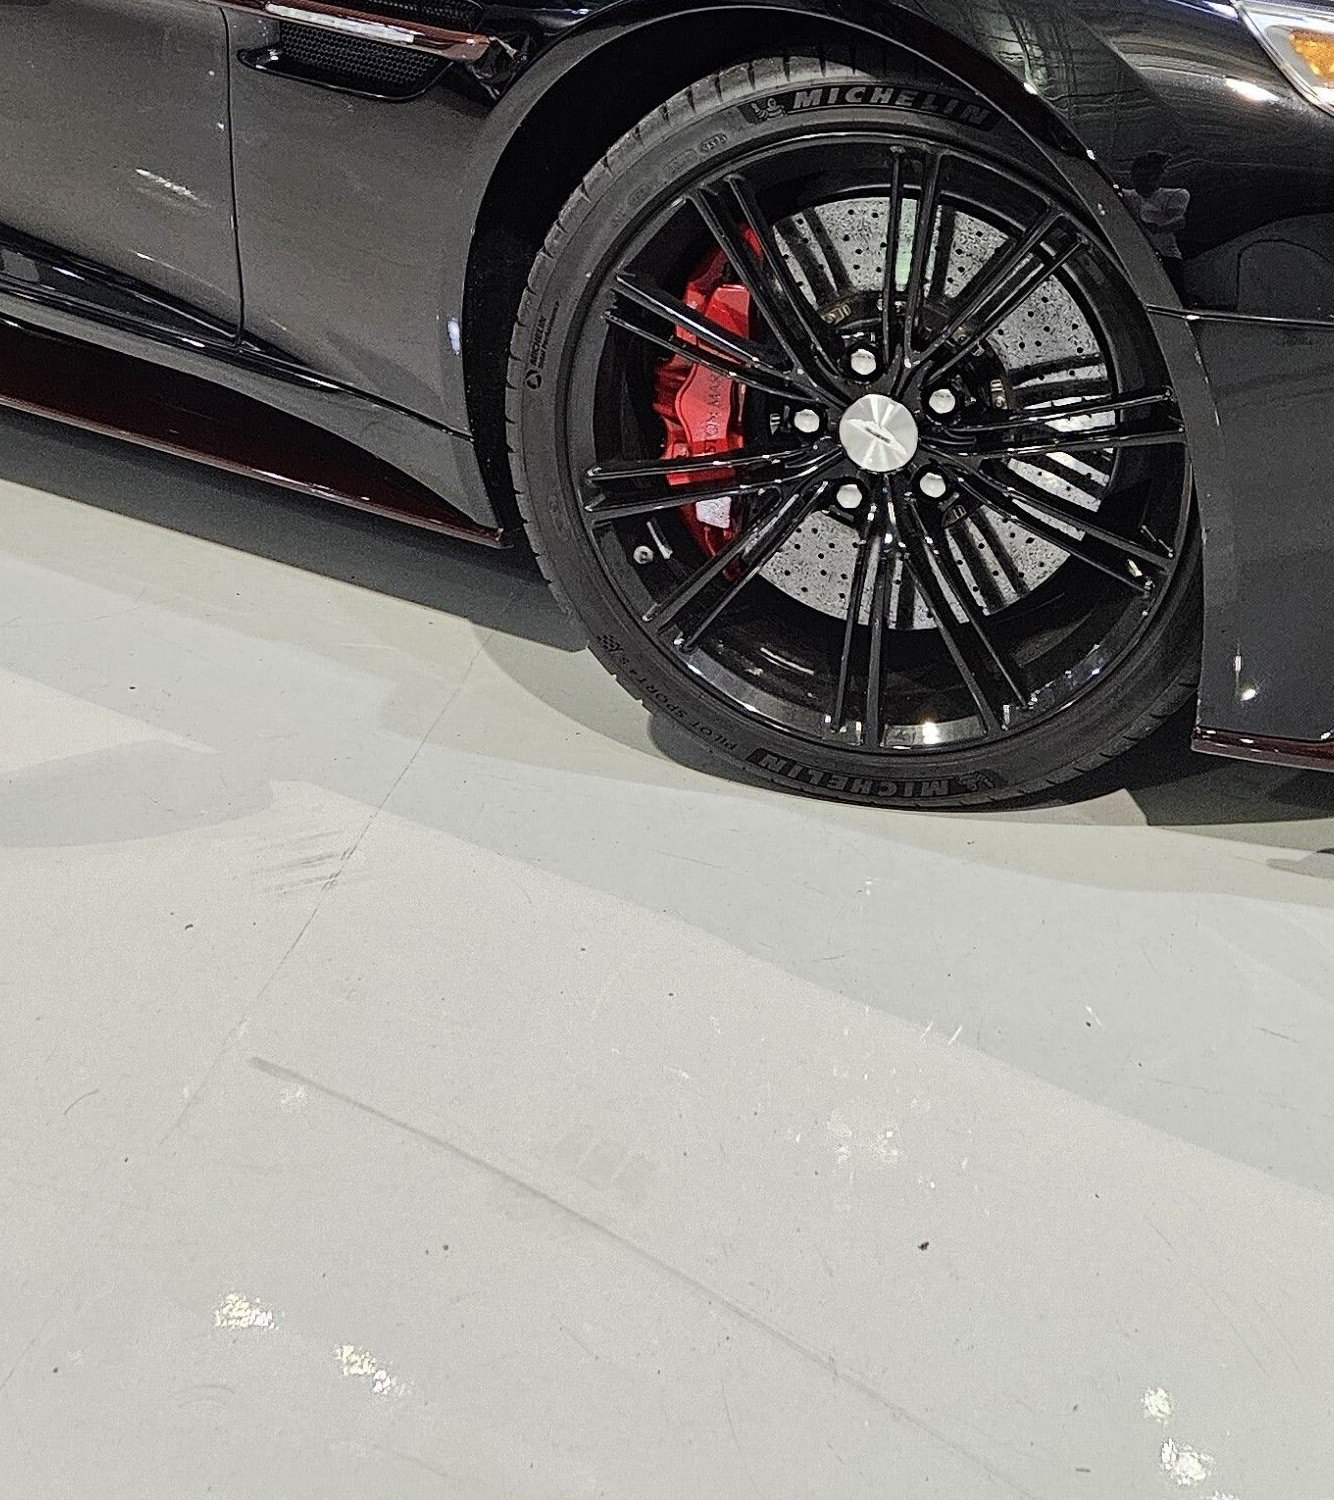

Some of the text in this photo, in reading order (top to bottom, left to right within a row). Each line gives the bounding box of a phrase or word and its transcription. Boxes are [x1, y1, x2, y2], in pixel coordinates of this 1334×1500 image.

[792, 86, 991, 124] MICHELIN
[638, 676, 687, 718] SPORT
[691, 722, 738, 751] PILOT
[759, 752, 949, 797] MICHELIN
